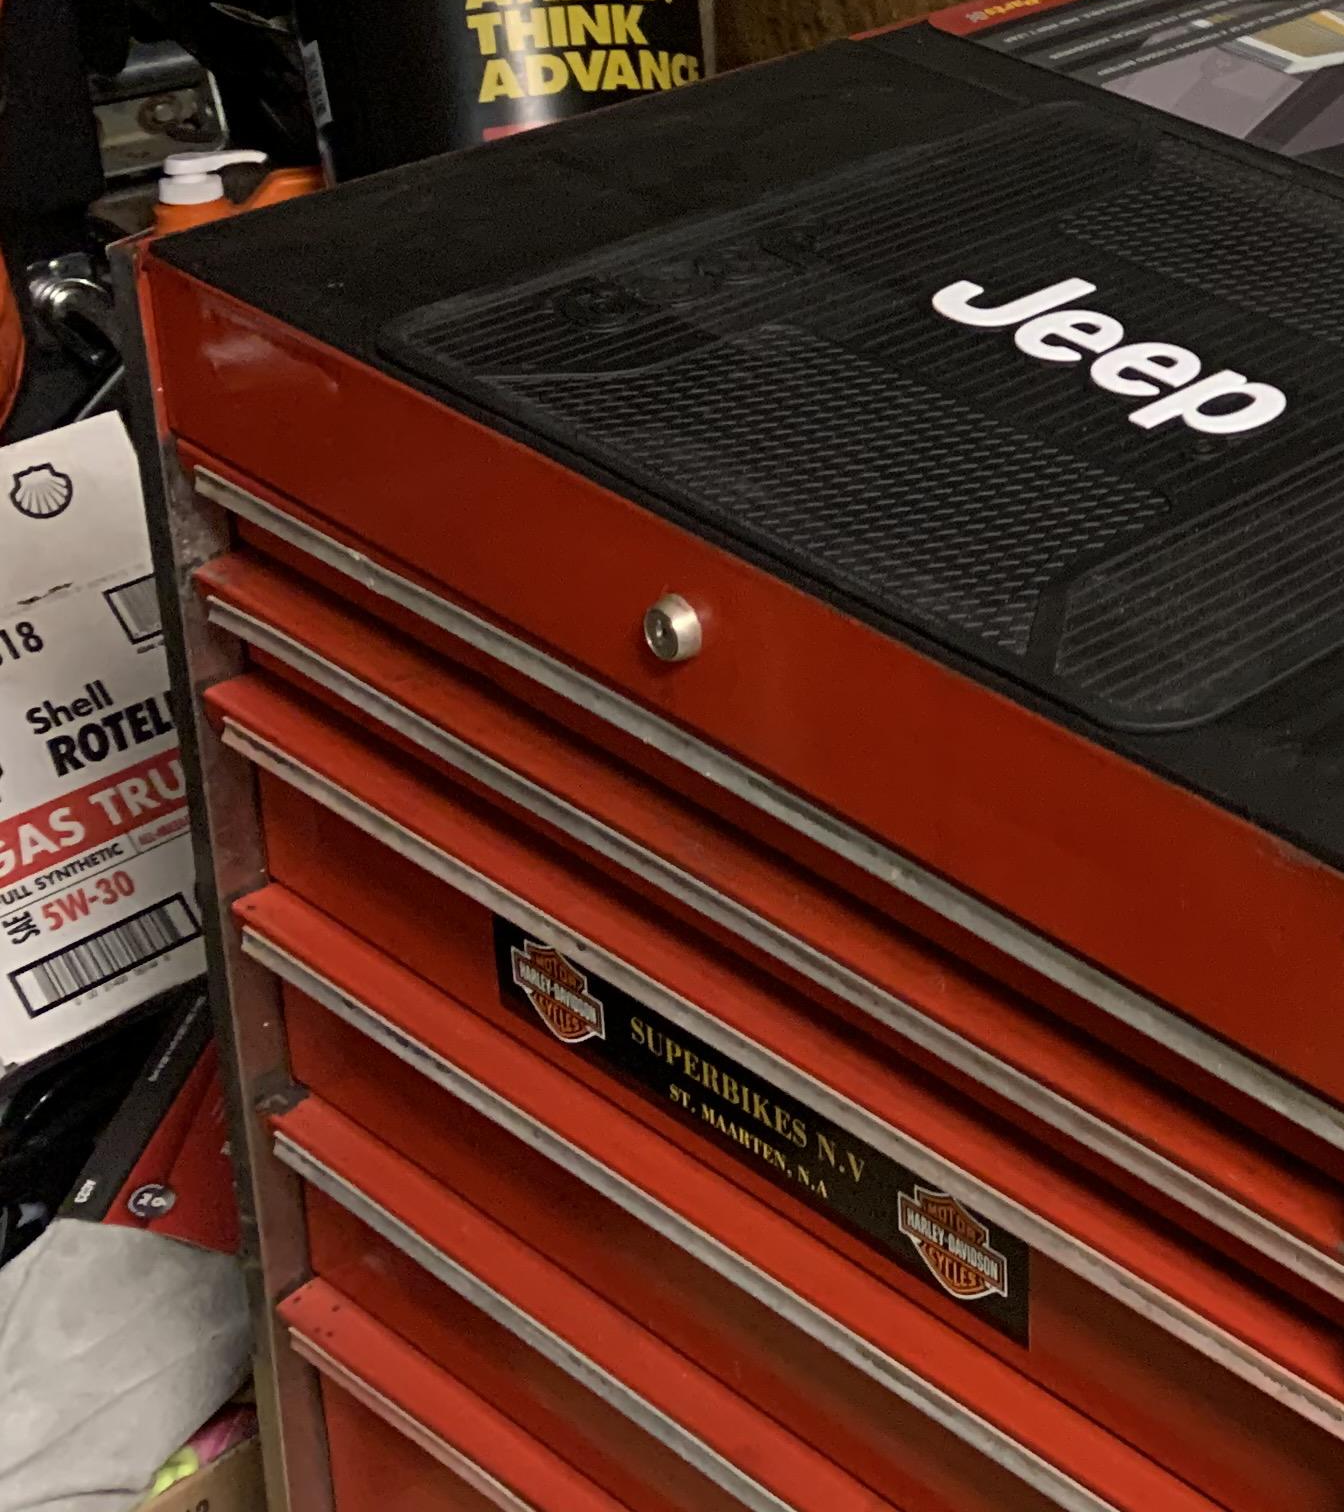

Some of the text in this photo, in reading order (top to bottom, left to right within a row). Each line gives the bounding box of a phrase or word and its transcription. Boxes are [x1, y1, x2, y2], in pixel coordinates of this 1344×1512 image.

[467, 5, 649, 55] THINK
[932, 277, 1287, 434] Jeep
[25, 679, 114, 735] Shell
[34, 842, 124, 891] SYNTHETIC
[2, 870, 136, 945] SAE 5W-30
[519, 961, 597, 1024] HARLEY-DAVIDSON
[629, 1016, 808, 1148] SUPERBIKES
[906, 1207, 998, 1281] HARLEY-DAVIDSON
